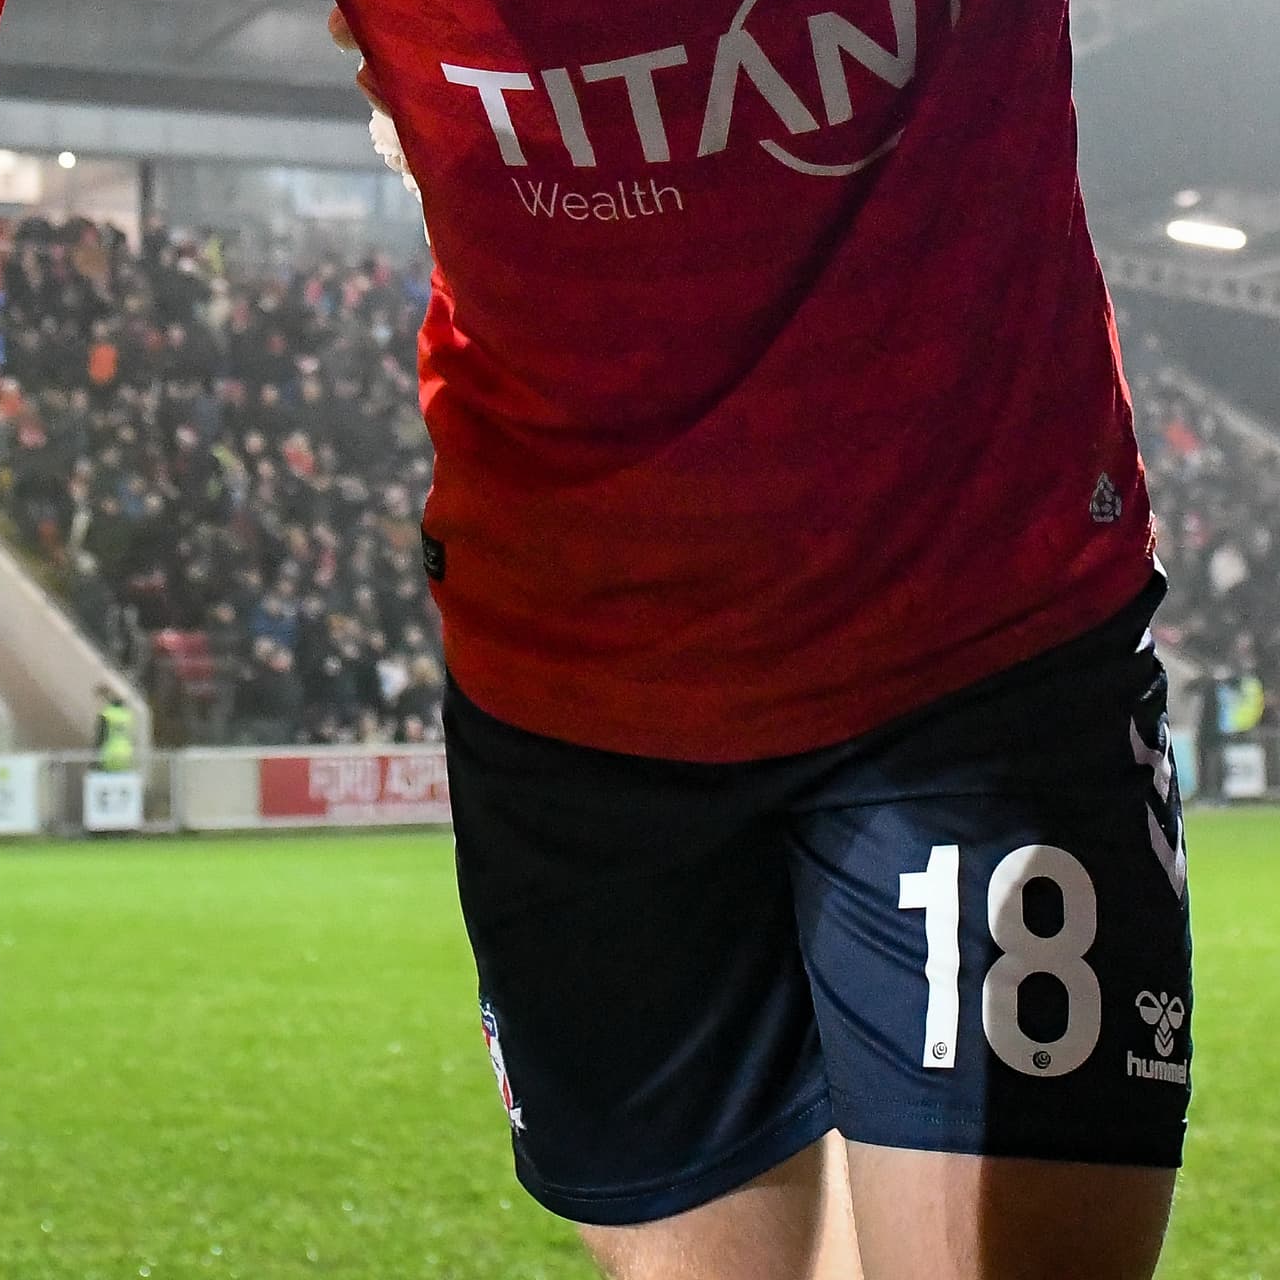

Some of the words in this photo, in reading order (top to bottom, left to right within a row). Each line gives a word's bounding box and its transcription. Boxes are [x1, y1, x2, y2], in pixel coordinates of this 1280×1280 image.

[511, 177, 685, 222] Wealth
[898, 843, 1102, 1077] 18
[1127, 1050, 1188, 1085] hummel
